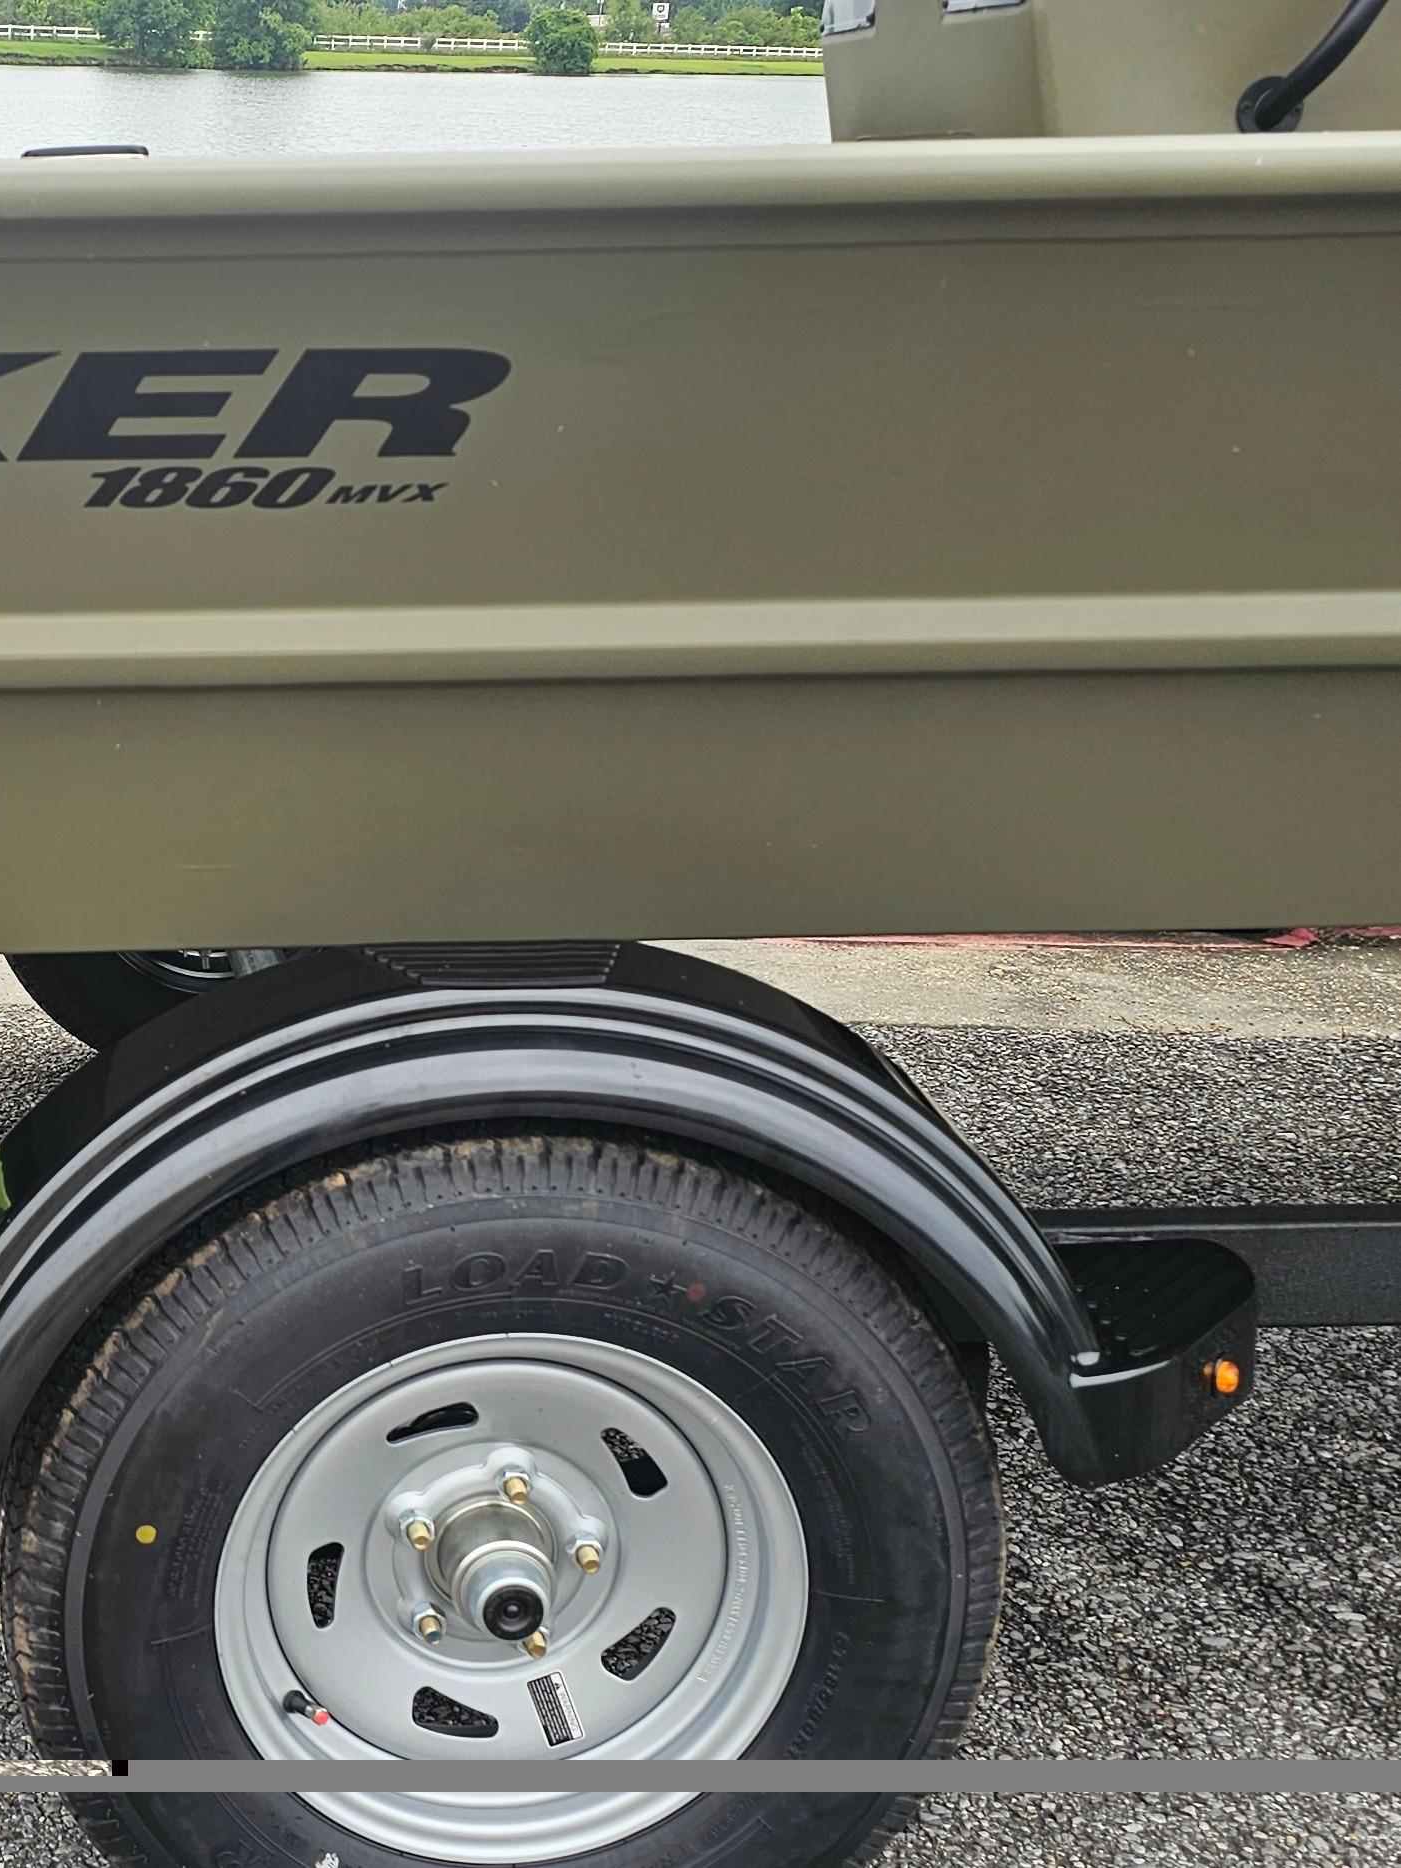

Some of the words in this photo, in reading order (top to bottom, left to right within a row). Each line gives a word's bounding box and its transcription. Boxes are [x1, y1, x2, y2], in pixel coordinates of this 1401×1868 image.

[84, 466, 336, 509] 1860
[325, 481, 449, 505] MVX
[402, 1248, 629, 1300] LOAD
[702, 1294, 874, 1441] STAR
